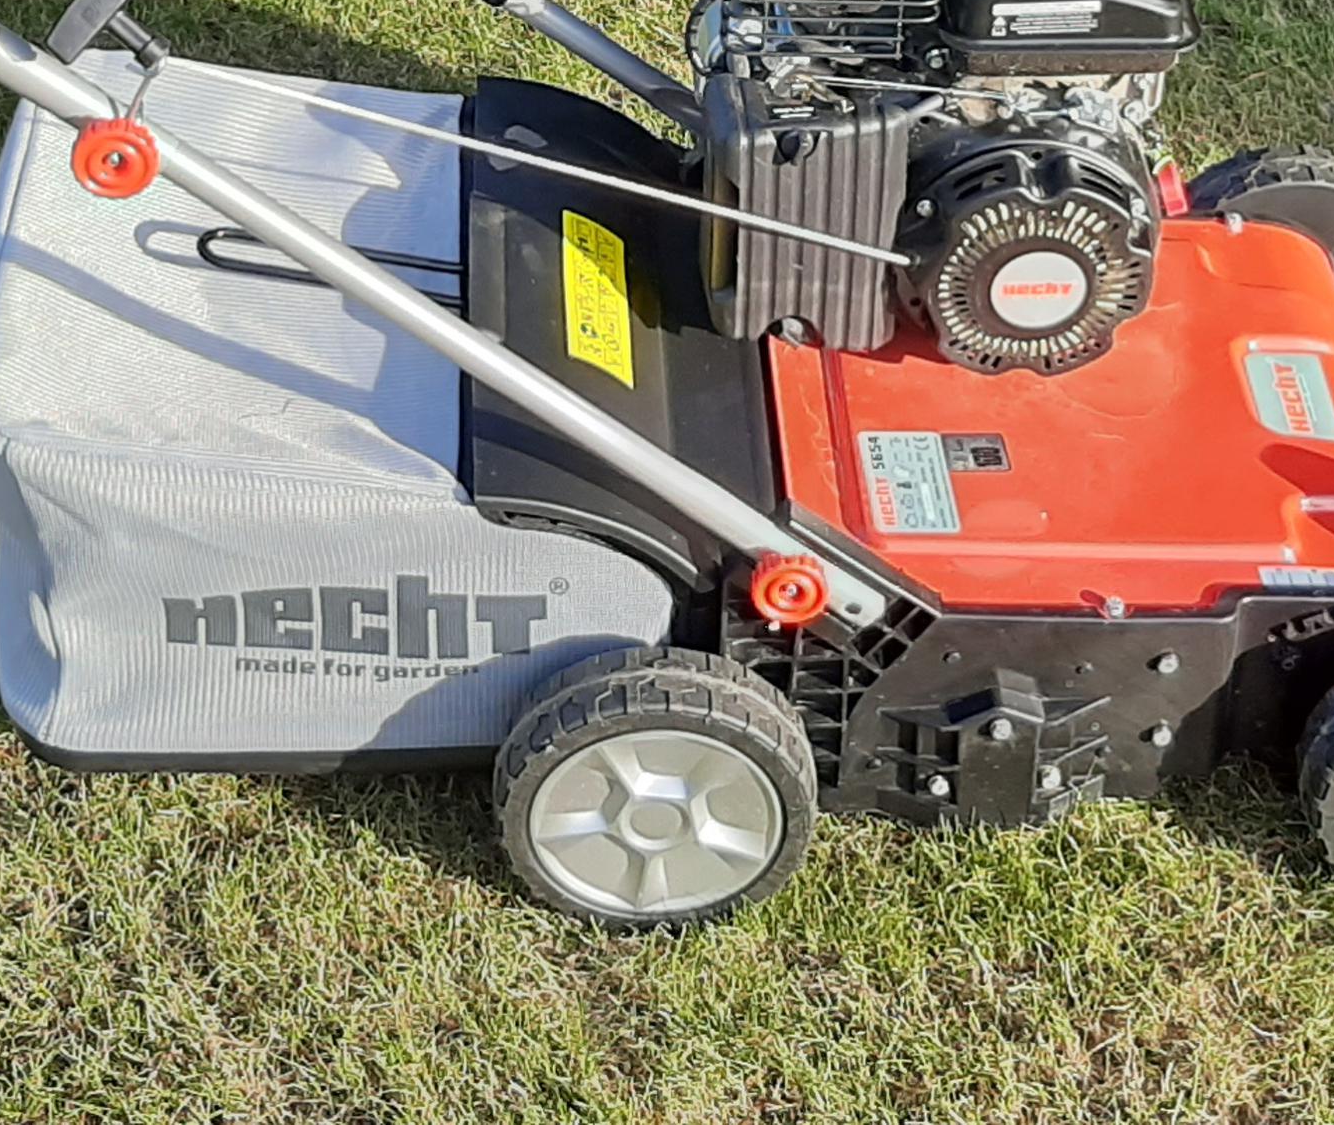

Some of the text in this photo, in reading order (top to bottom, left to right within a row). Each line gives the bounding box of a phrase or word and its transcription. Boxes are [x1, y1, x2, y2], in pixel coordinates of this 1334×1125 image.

[868, 436, 886, 470] 5654
[235, 655, 480, 683] made for garden
